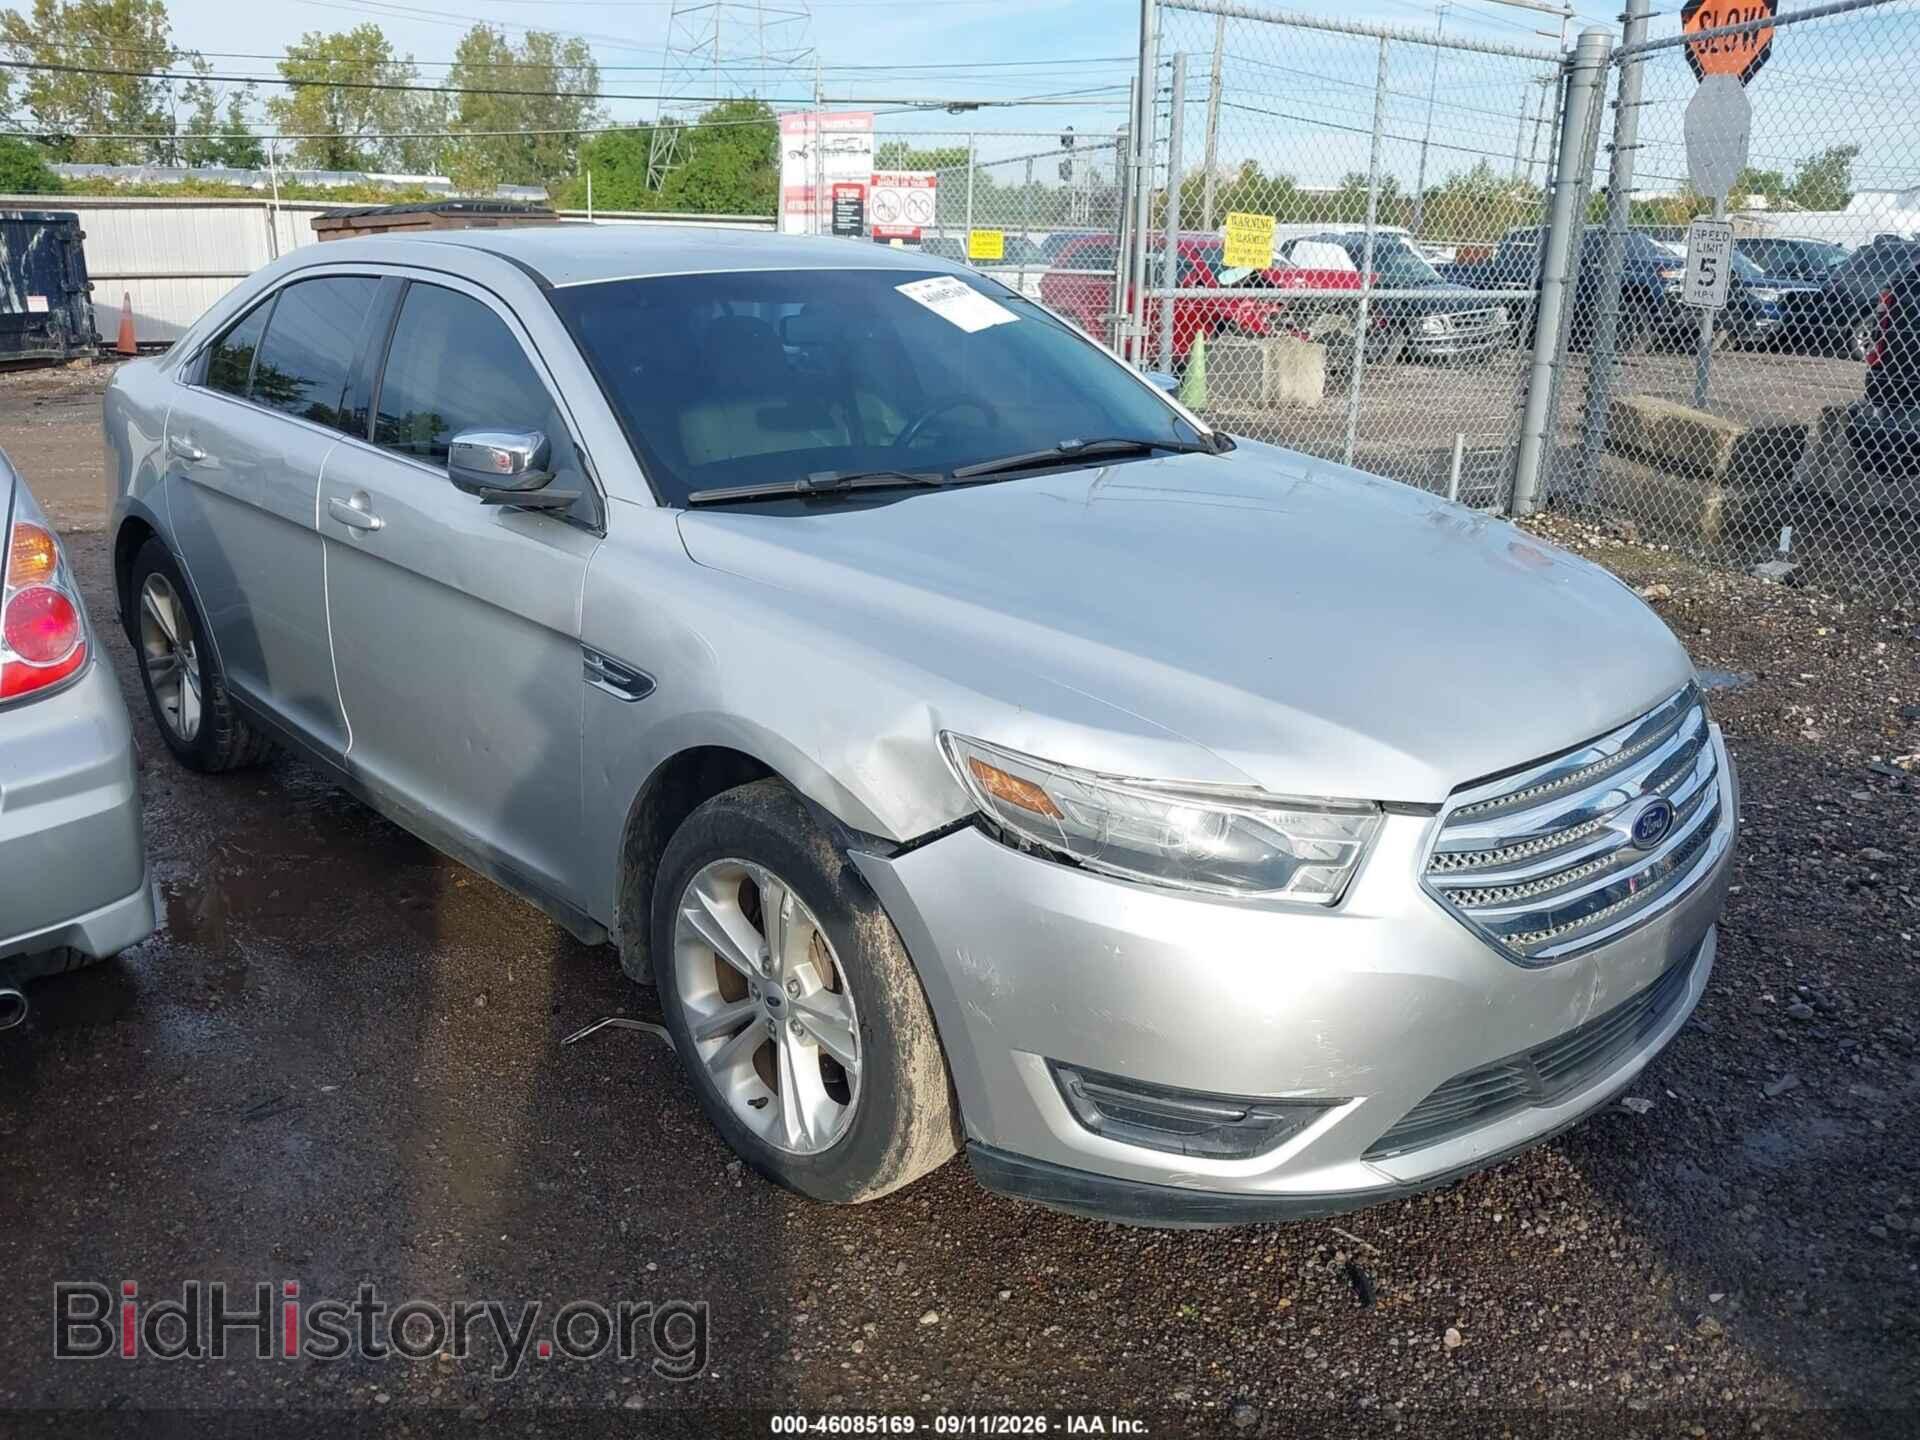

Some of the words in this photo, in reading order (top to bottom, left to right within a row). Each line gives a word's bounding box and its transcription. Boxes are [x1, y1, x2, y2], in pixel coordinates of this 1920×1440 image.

[1697, 5, 1765, 55] SLOW
[1694, 229, 1730, 242] SPEED
[1697, 242, 1724, 255] LIMIT
[1698, 257, 1717, 287] 5
[1641, 811, 1663, 837] Ford
